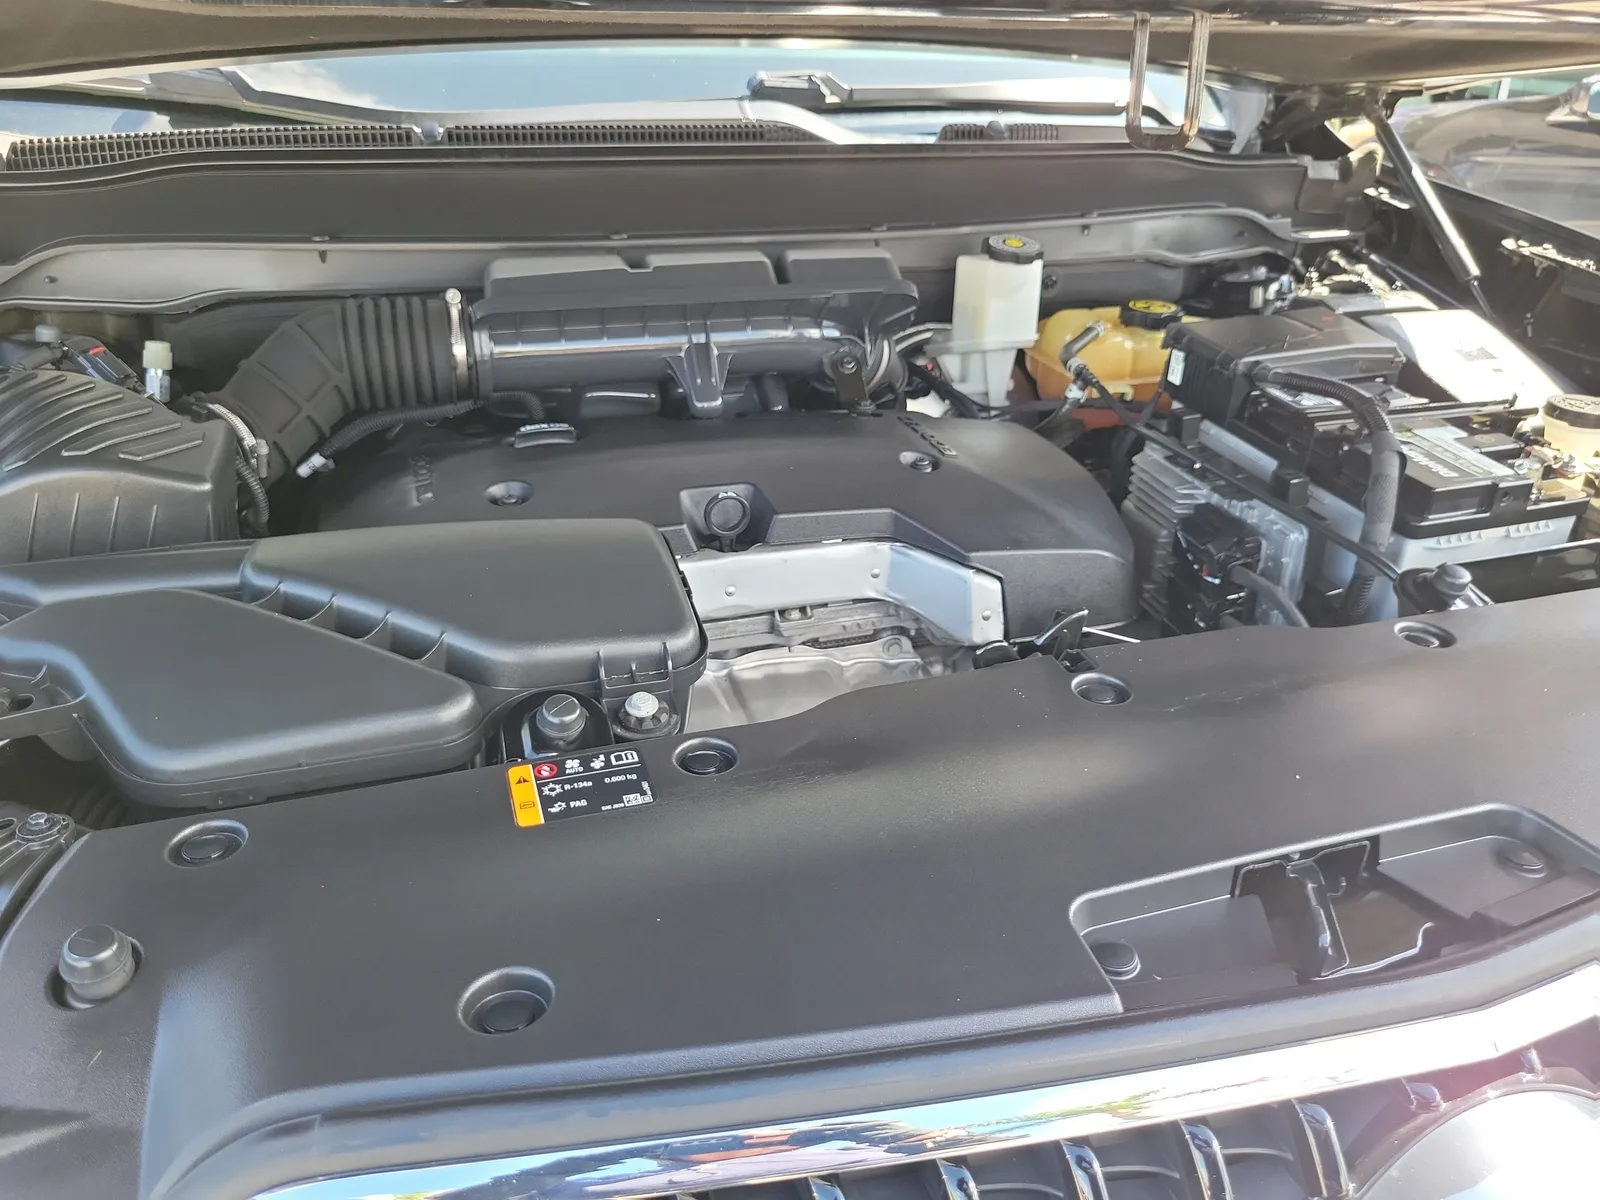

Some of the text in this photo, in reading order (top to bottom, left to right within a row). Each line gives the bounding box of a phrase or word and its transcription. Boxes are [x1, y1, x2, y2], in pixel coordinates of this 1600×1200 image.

[565, 766, 584, 774] AUTO
[564, 781, 593, 791] R-134a
[569, 799, 588, 808] PAG
